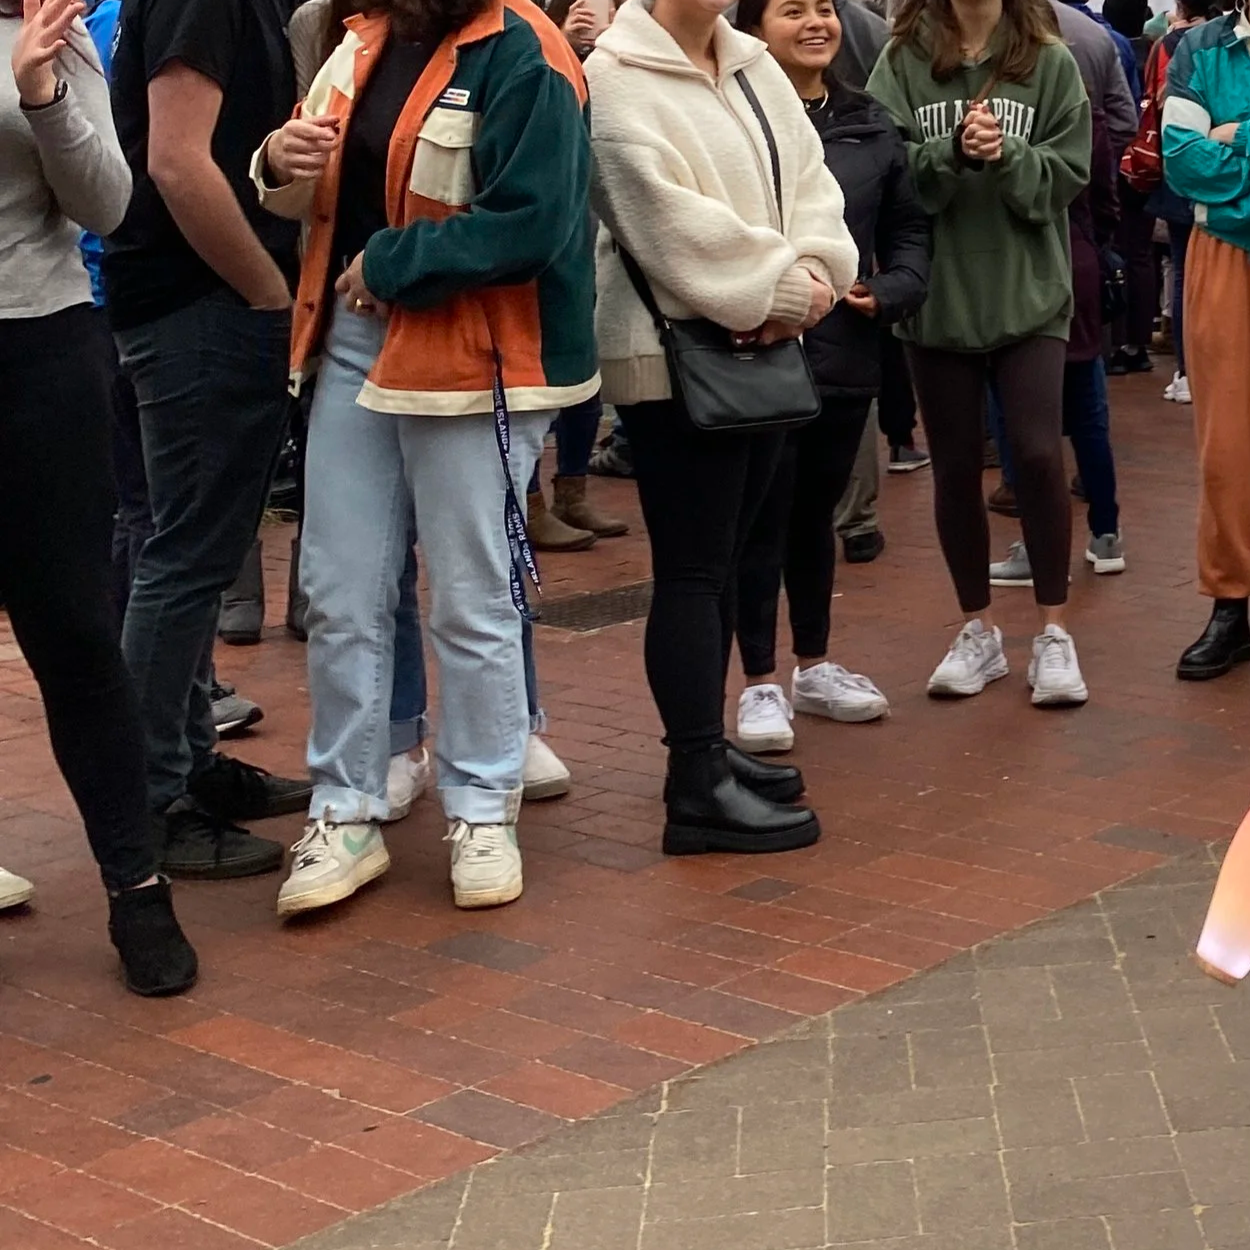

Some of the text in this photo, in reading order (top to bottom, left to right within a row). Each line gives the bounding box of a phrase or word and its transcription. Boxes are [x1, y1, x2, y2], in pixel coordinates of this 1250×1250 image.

[914, 98, 1035, 142] HILAPHIA
[496, 409, 509, 445] ISLAND
[512, 512, 527, 541] RAMS
